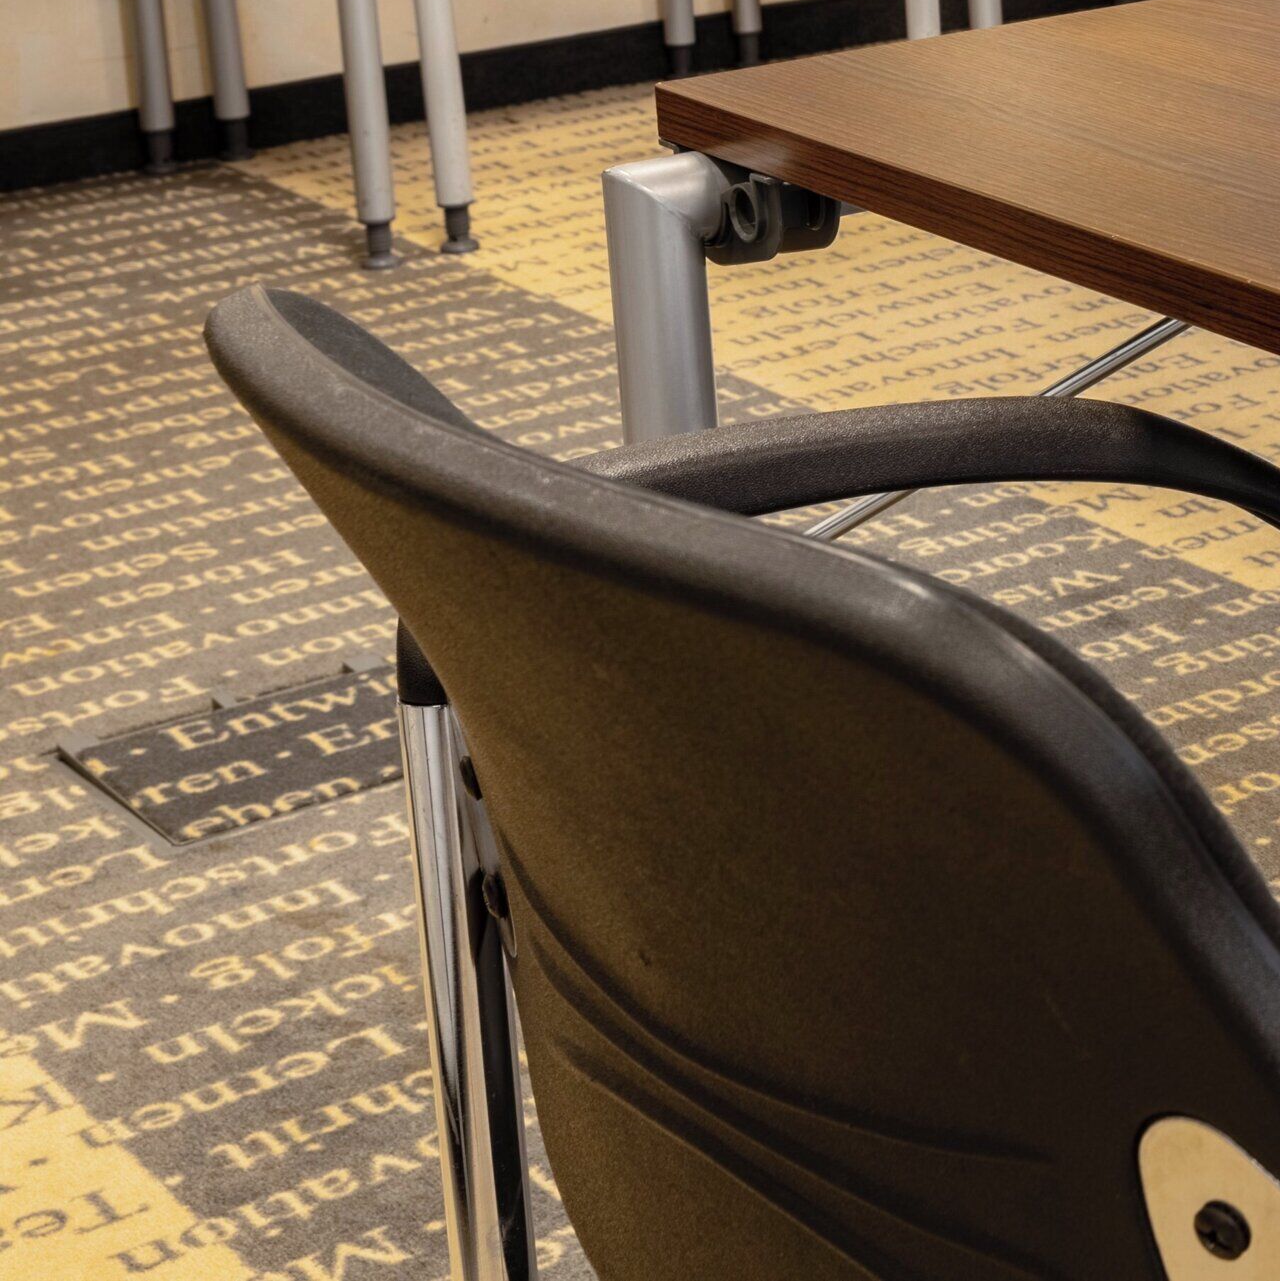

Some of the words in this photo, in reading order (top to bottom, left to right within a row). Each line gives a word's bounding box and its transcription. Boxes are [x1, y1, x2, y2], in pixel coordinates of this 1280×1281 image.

[742, 344, 1028, 417] Innovation
[782, 315, 1047, 386] Fortschritt
[890, 486, 1152, 559] Meeting
[91, 547, 316, 608] Hören
[6, 588, 396, 697] Innovation
[62, 1022, 413, 1152] Lernen
